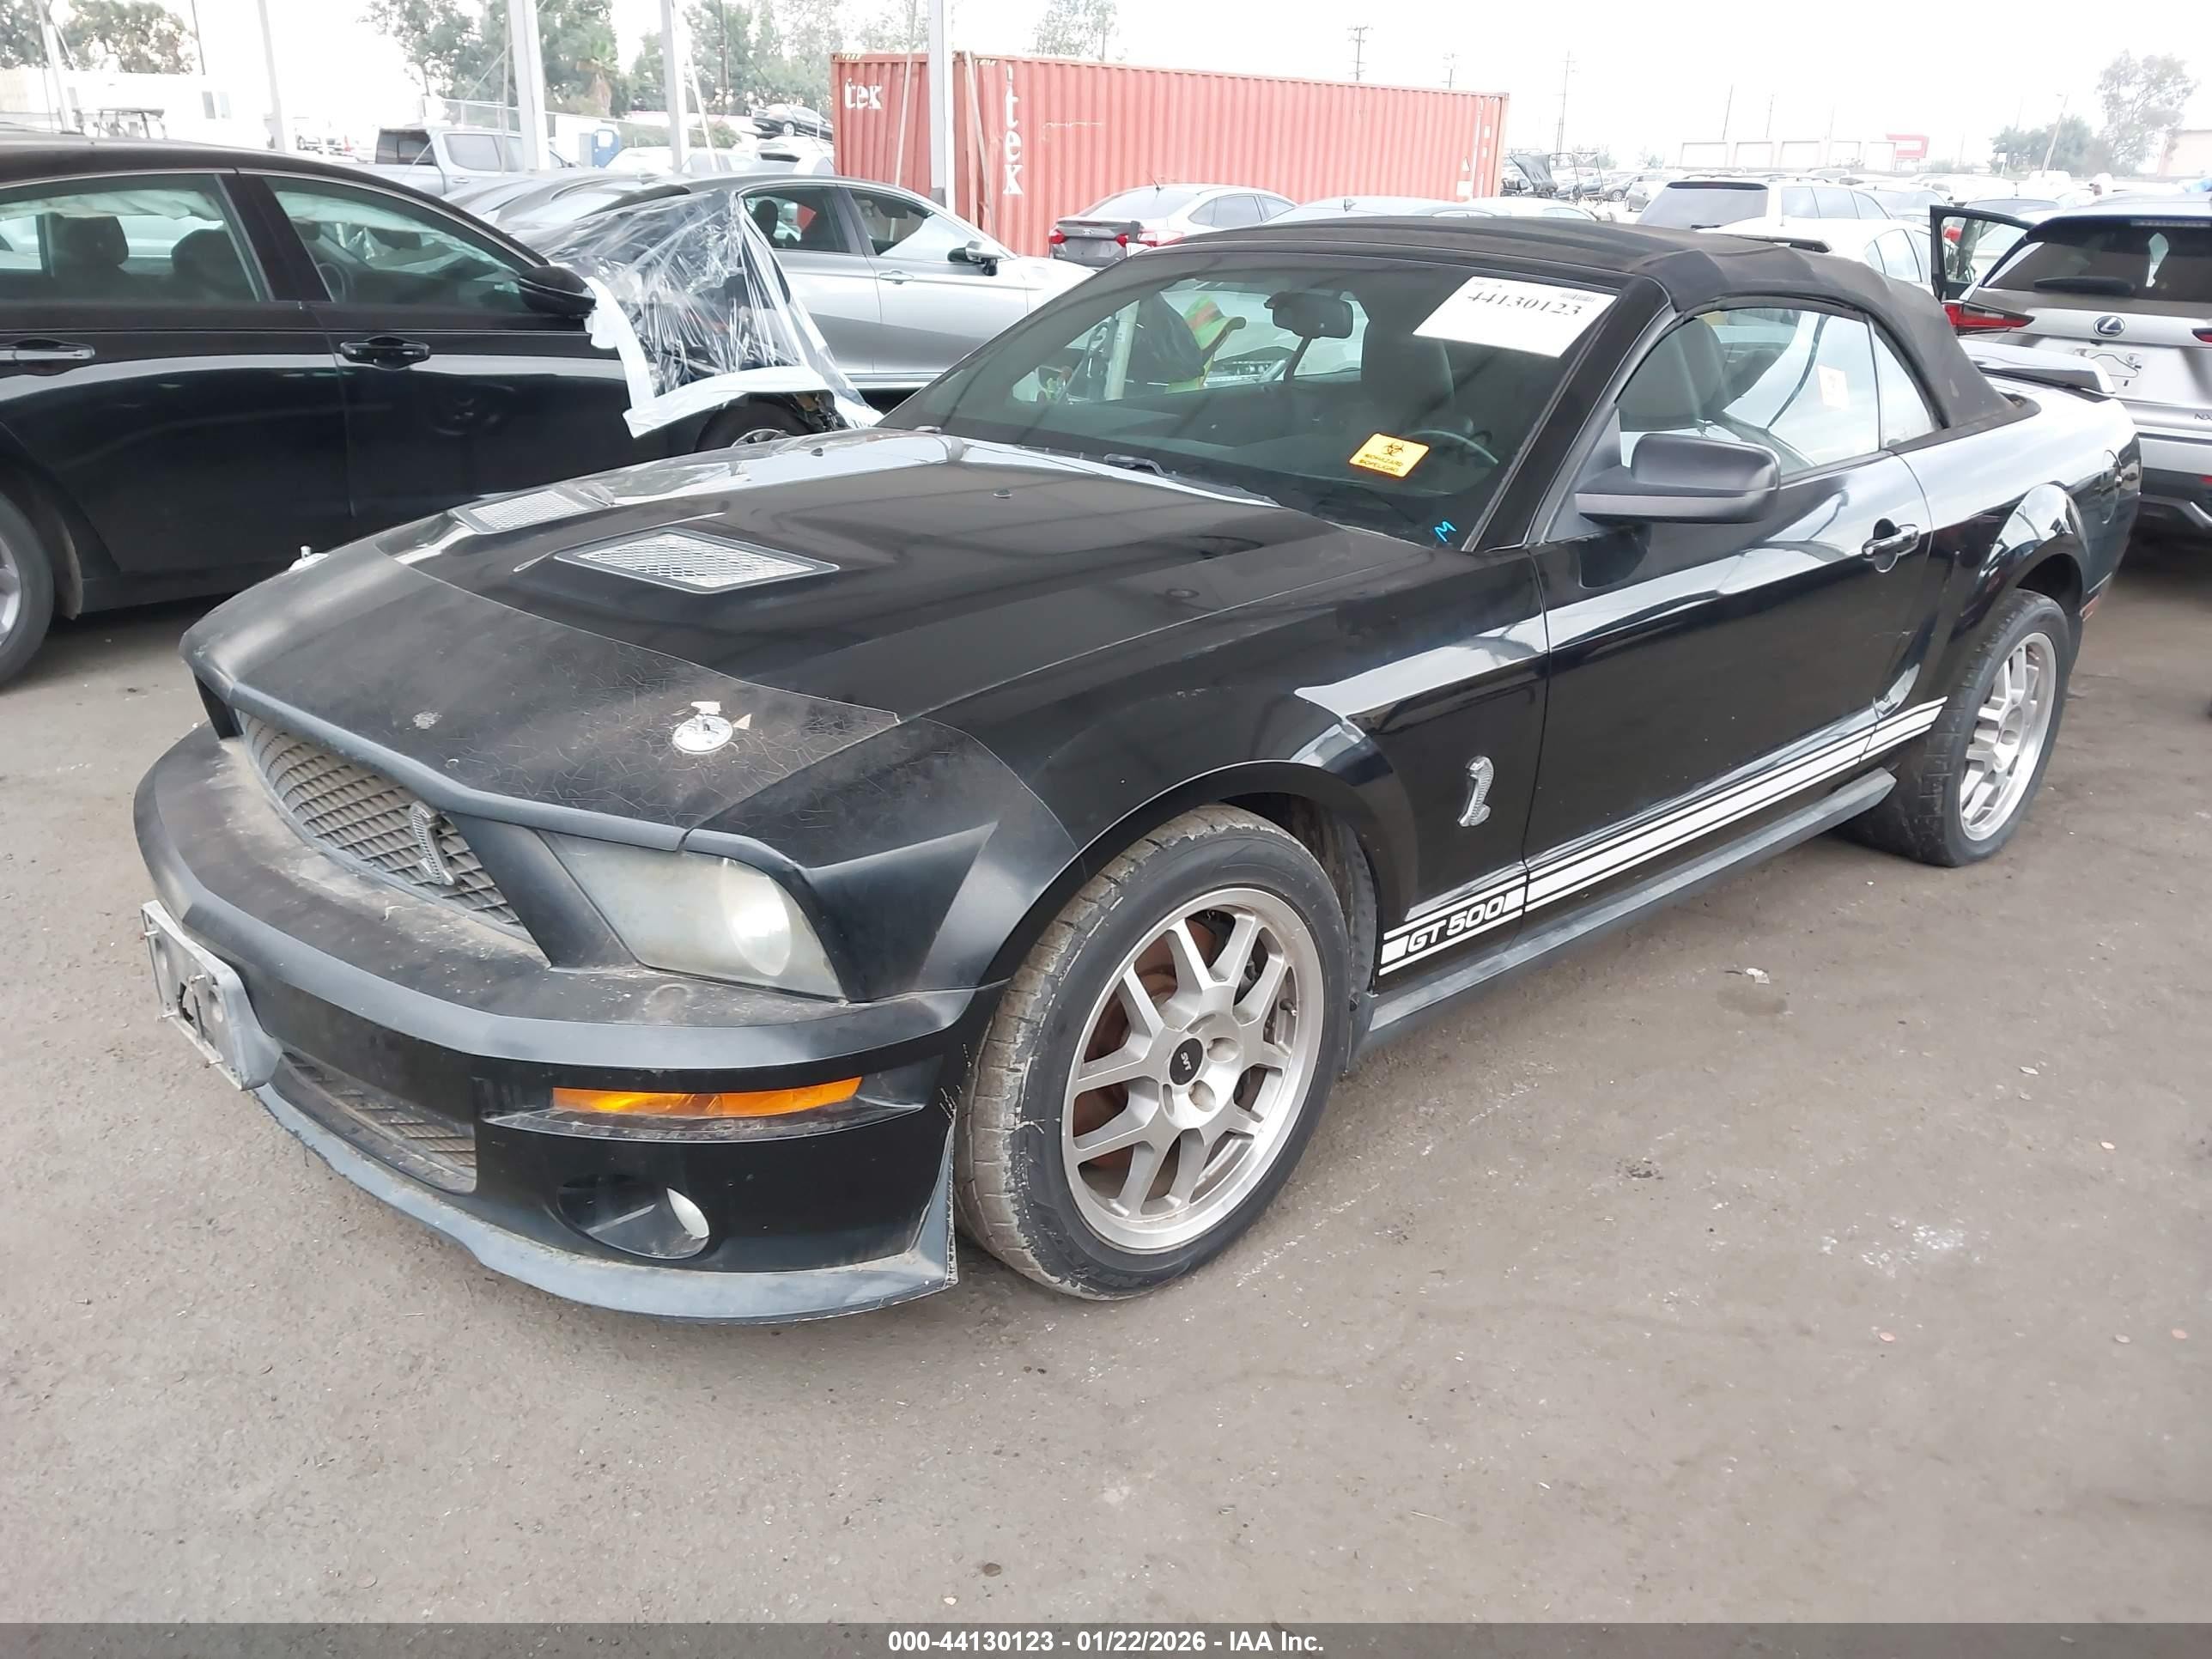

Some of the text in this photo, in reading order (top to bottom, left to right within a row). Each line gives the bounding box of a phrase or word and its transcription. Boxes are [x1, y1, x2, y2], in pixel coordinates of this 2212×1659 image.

[1466, 291, 1583, 316] 44130123
[1407, 895, 1506, 953] GT 500
[1180, 1051, 1193, 1072] SVT
